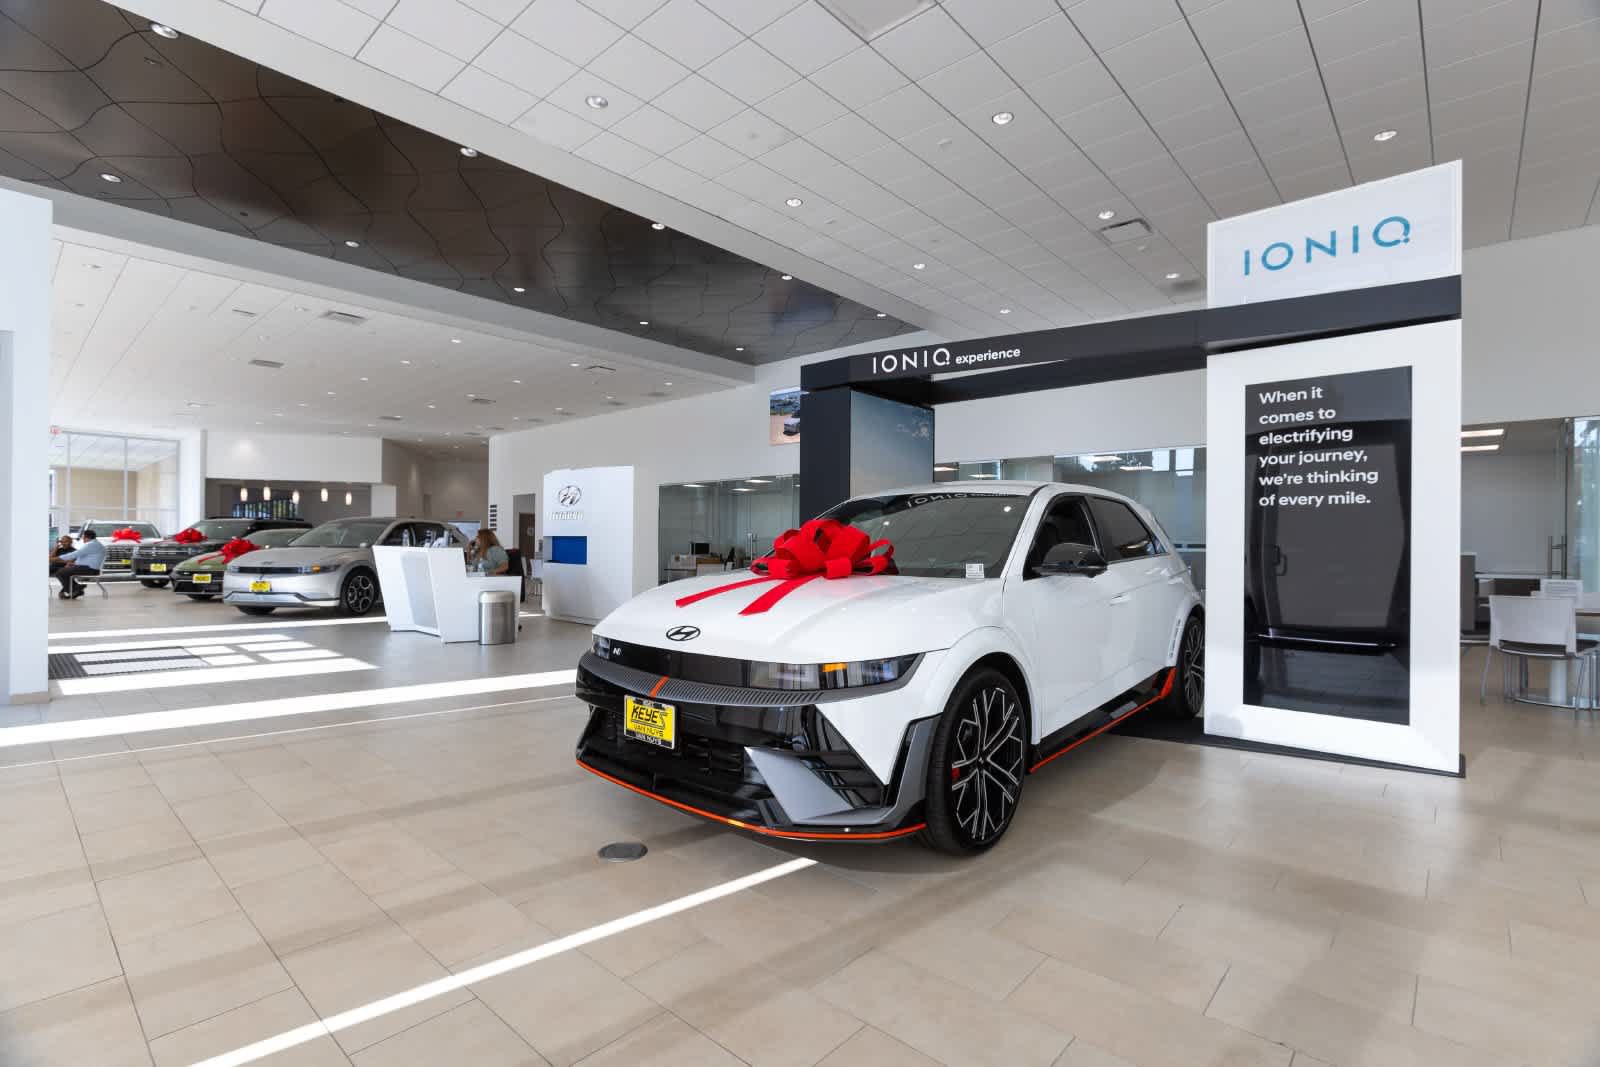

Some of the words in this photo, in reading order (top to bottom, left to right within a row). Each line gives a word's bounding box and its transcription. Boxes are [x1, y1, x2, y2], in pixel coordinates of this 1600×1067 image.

[1243, 215, 1411, 276] IONIQ
[873, 348, 950, 374] IONIQ
[955, 347, 1021, 365] experience
[1259, 390, 1308, 405] When
[1311, 386, 1323, 399] it
[1259, 411, 1314, 425] comes
[1318, 408, 1336, 419] to
[1259, 428, 1353, 445] electrifying
[1259, 454, 1295, 468] your
[1298, 449, 1368, 465] journey,
[1306, 469, 1379, 484] thinking
[631, 704, 667, 729] KEYES
